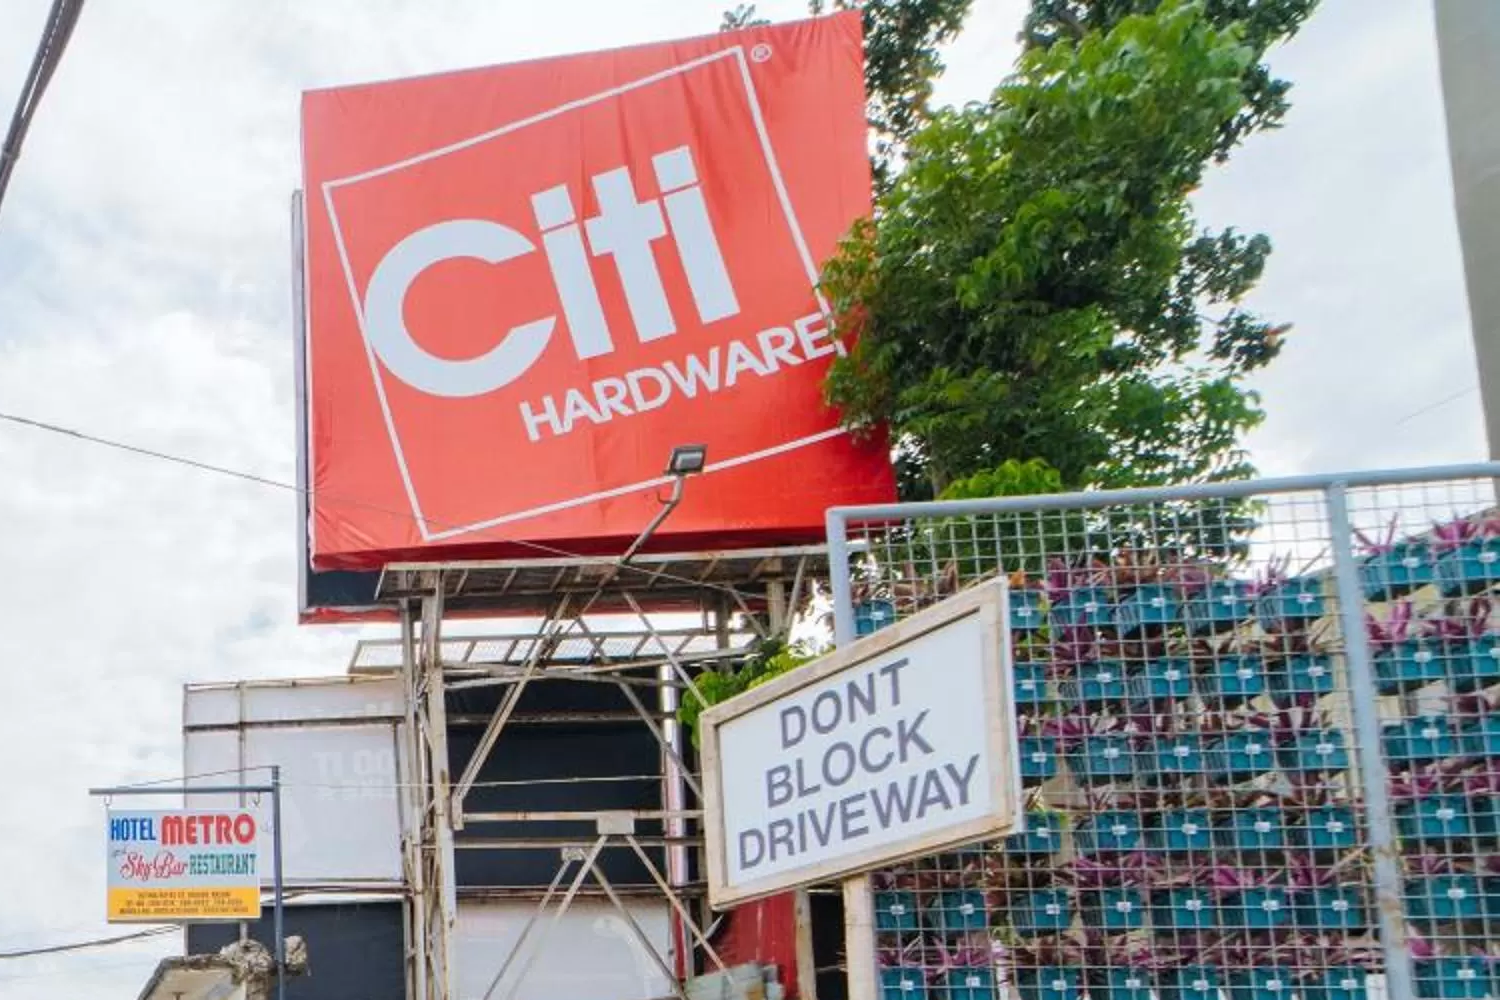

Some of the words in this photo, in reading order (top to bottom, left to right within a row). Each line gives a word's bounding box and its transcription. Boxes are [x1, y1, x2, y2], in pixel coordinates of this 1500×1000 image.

[519, 311, 837, 443] HARDWARE
[779, 657, 909, 750] DONT
[766, 708, 935, 809] BLOCK
[110, 817, 157, 841] HOTEL
[161, 813, 256, 845] METRO
[739, 753, 981, 871] DRIVEWAY
[189, 853, 257, 875] RESTAURANT
